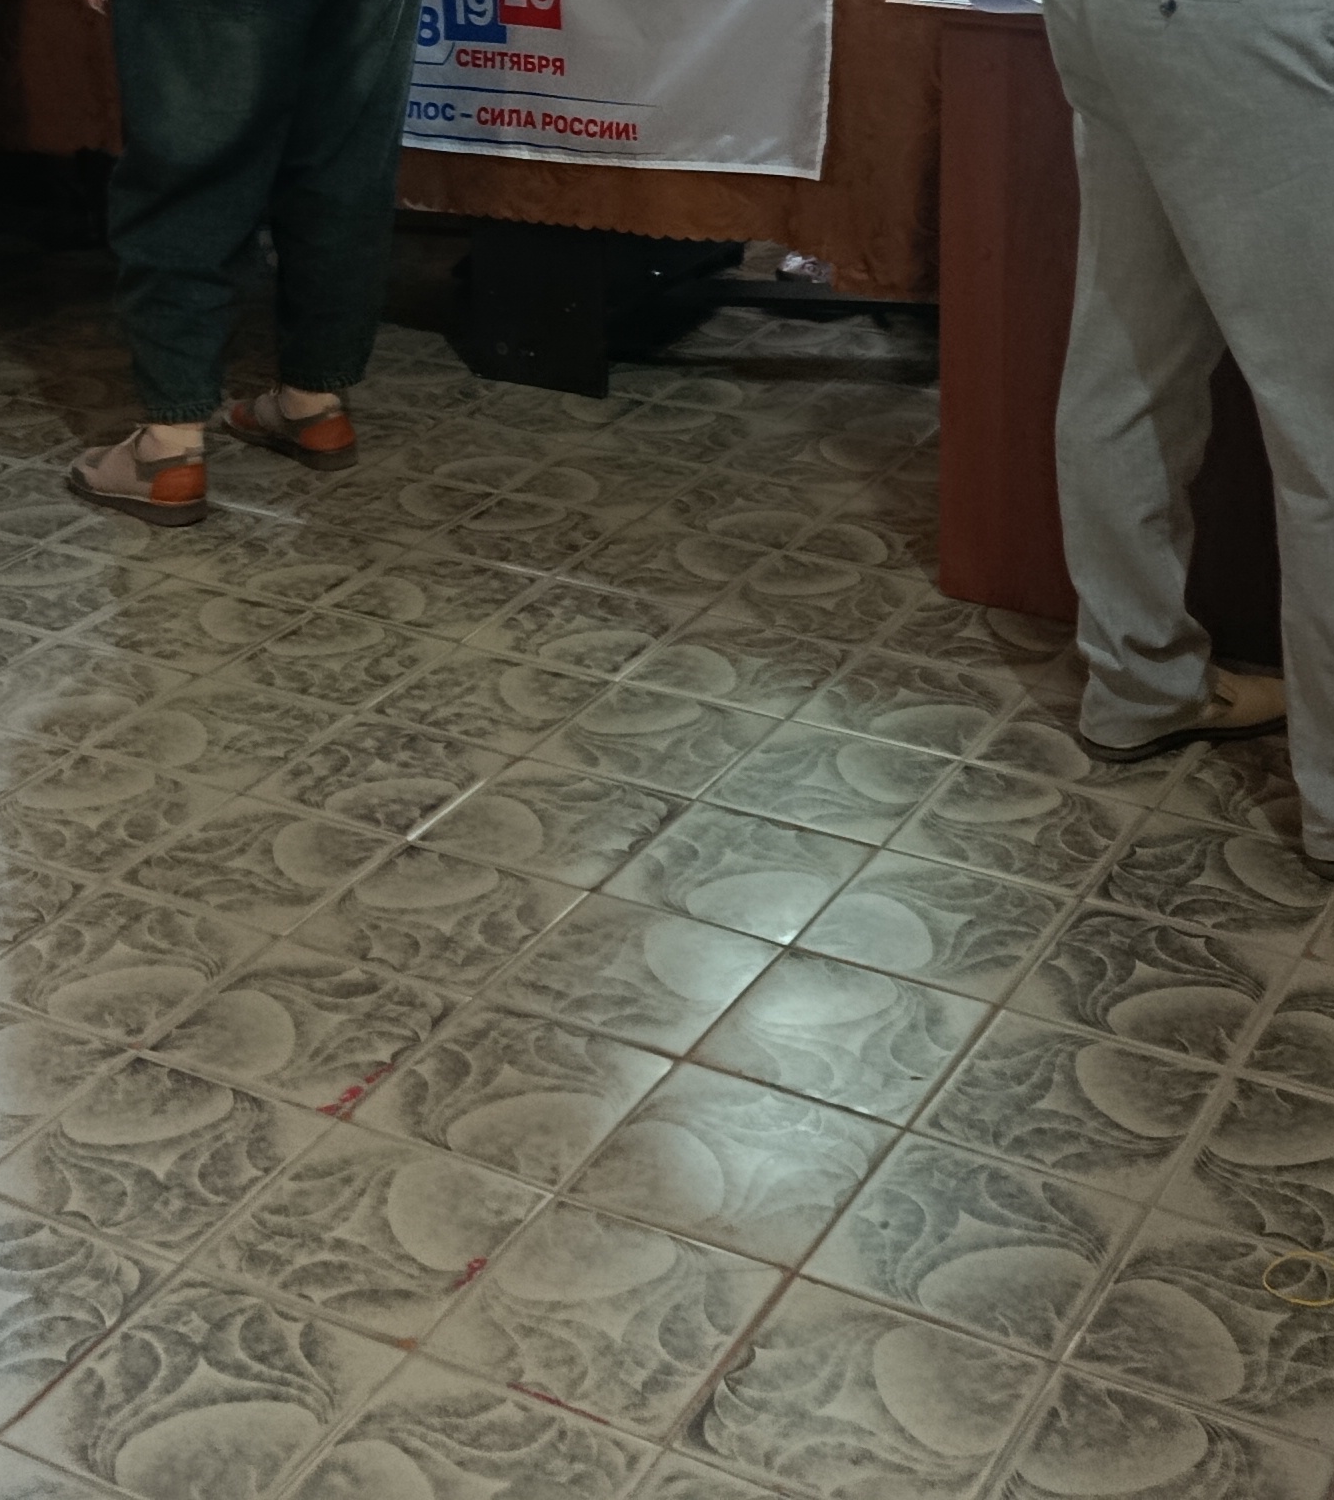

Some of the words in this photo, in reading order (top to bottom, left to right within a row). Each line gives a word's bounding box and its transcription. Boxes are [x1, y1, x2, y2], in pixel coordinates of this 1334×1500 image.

[417, 5, 441, 47] 8
[455, 48, 565, 76] СЕНТЯБРЯ
[408, 101, 455, 121] ЛОС
[476, 106, 536, 130] СИЛА
[541, 112, 638, 141] РОССИИ!
